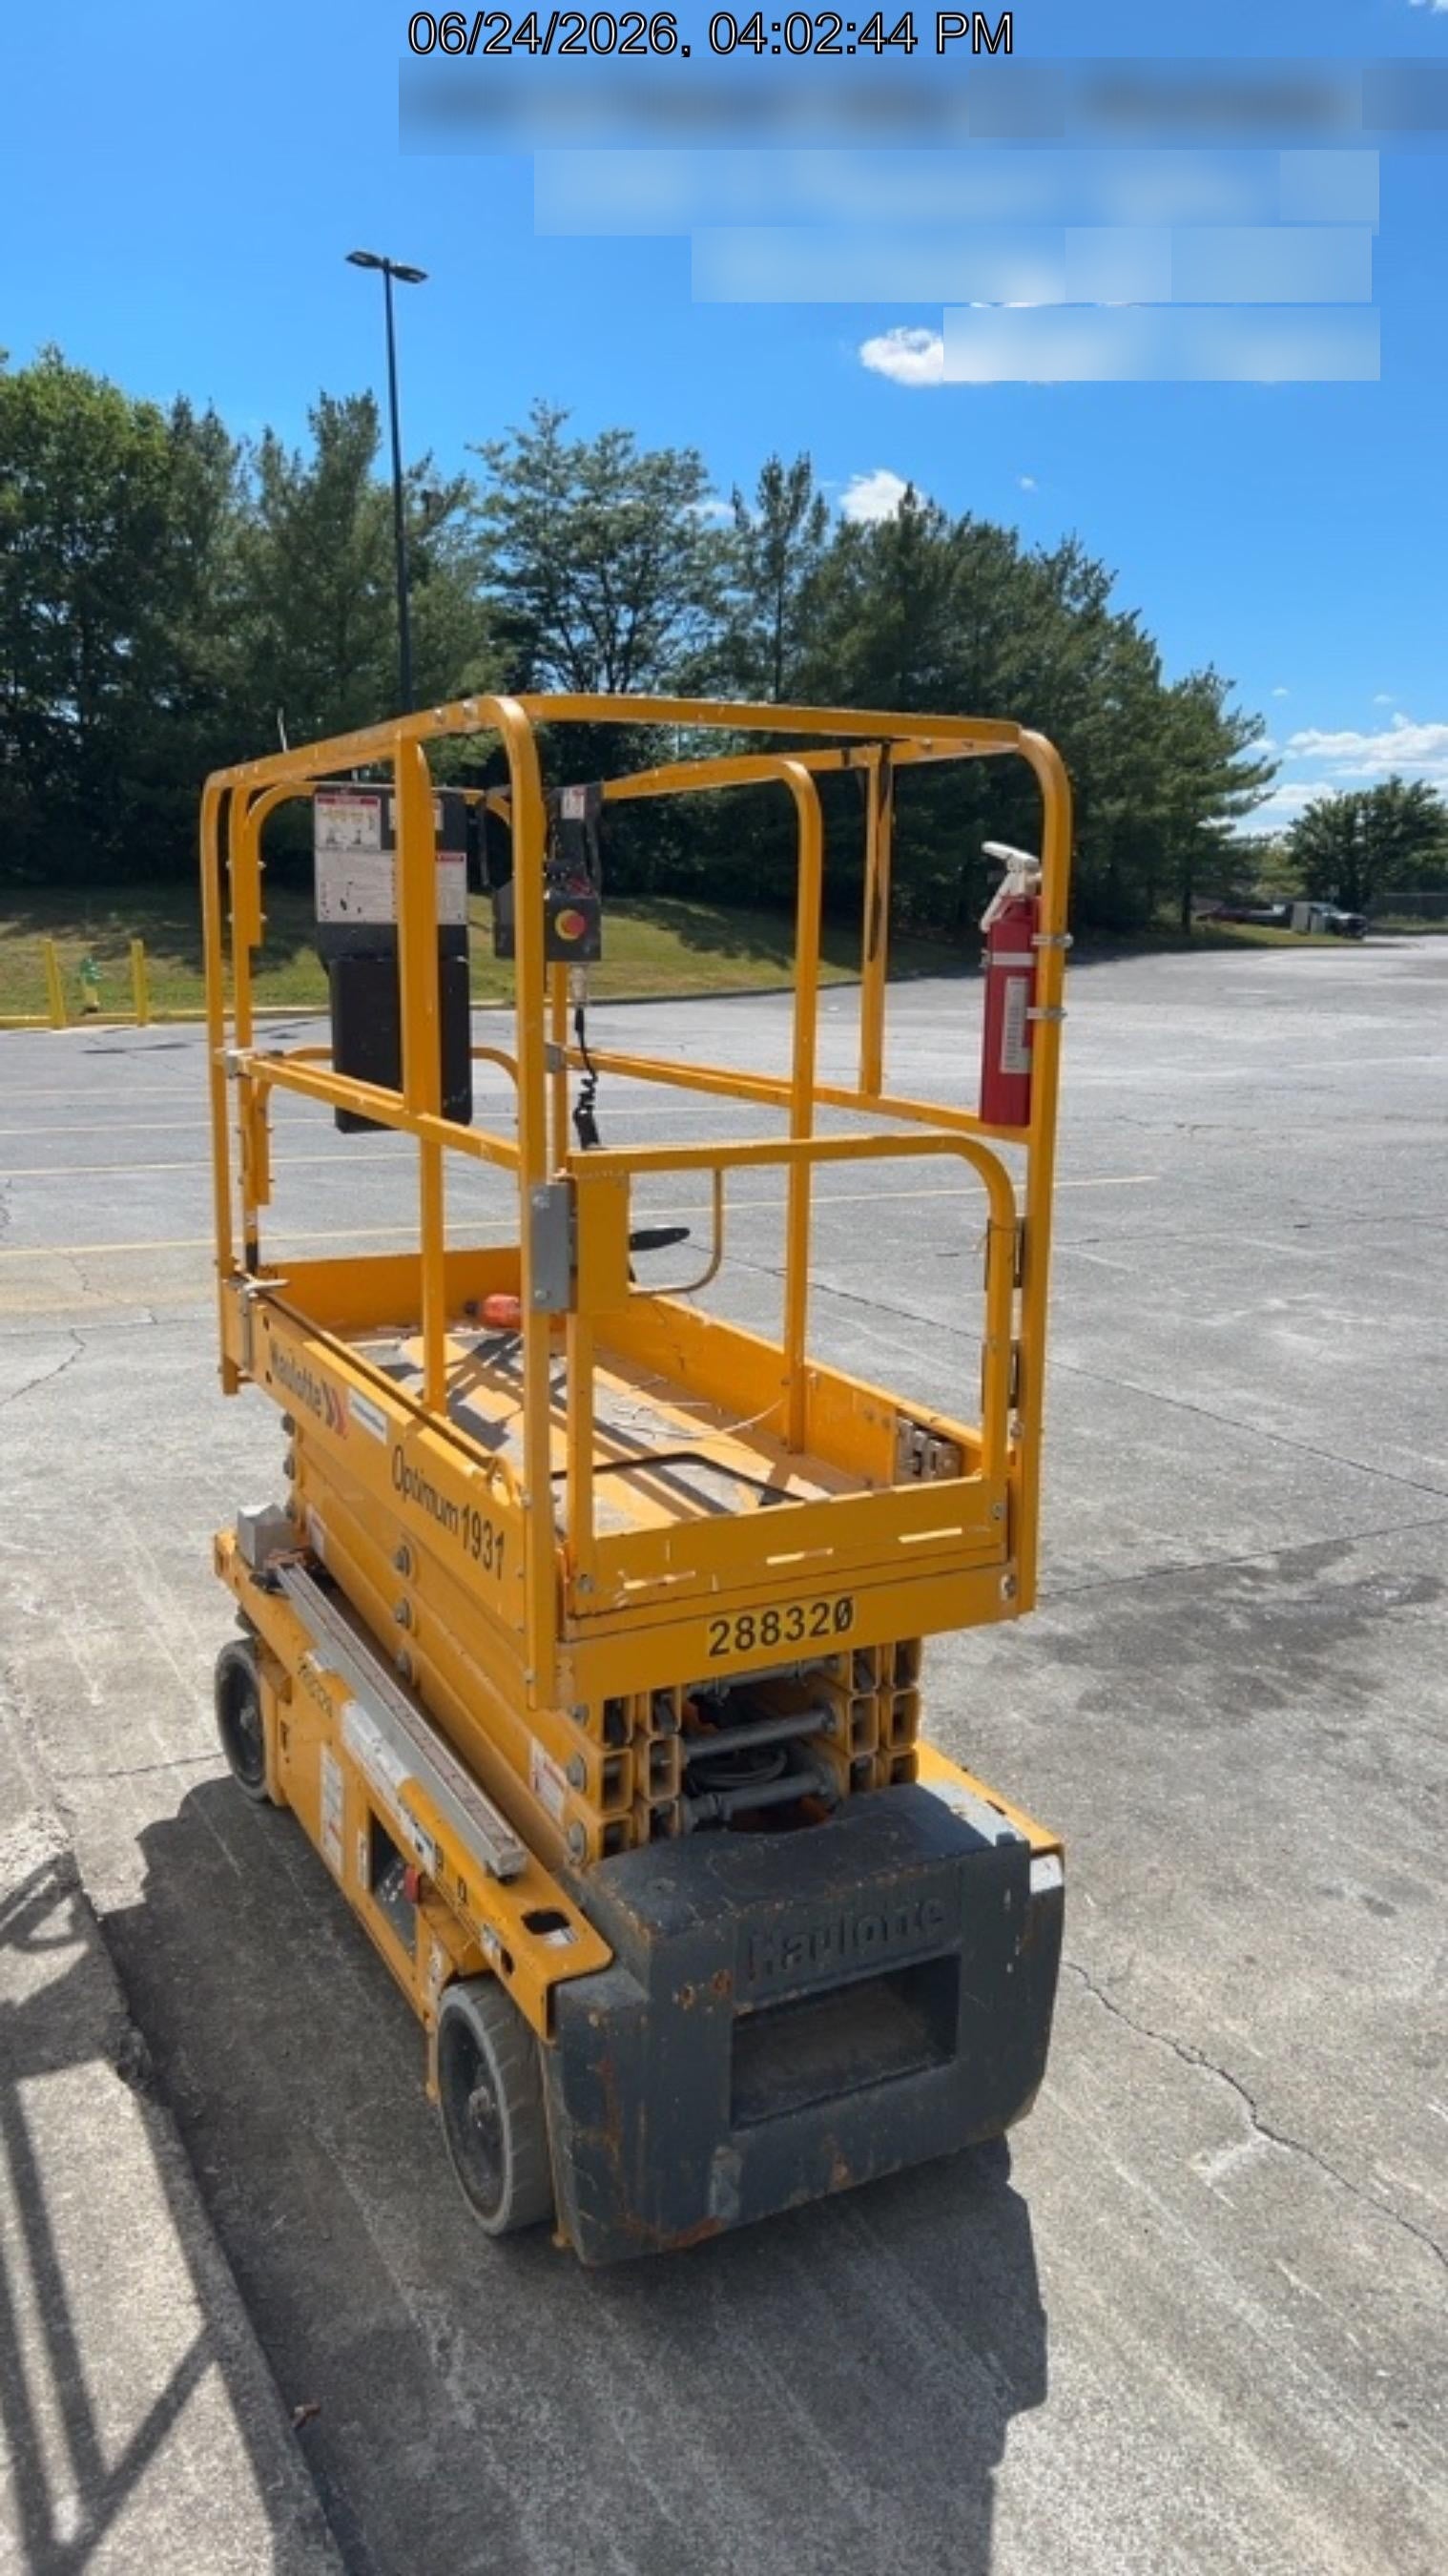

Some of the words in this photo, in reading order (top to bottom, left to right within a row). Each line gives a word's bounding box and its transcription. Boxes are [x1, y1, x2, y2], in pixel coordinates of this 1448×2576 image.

[392, 1444, 459, 1538] Optimum
[461, 1504, 505, 1580] 1931
[709, 1595, 853, 1657] 288320
